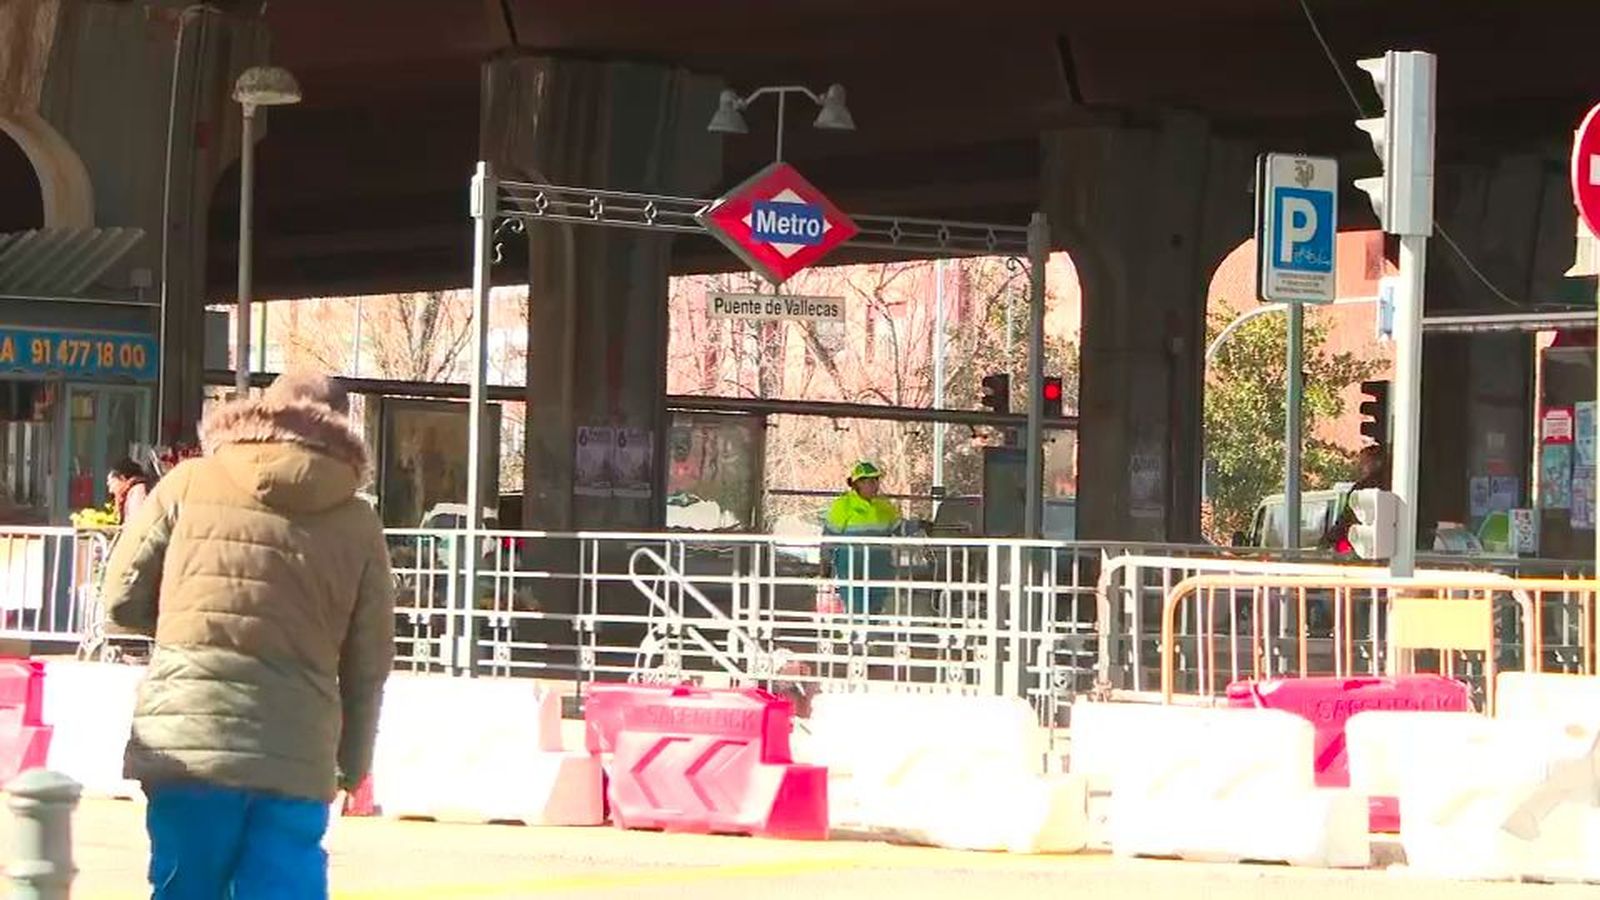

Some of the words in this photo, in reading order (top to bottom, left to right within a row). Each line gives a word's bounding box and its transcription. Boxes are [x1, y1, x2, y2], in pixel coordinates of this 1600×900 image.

[756, 209, 820, 237] Metro
[1280, 196, 1318, 262] P
[714, 298, 761, 315] Puente
[765, 299, 782, 315] de
[785, 299, 838, 317] Vallecas
[31, 339, 51, 365] 91
[58, 340, 91, 366] 477
[97, 341, 114, 368] 18
[120, 343, 146, 370] 00
